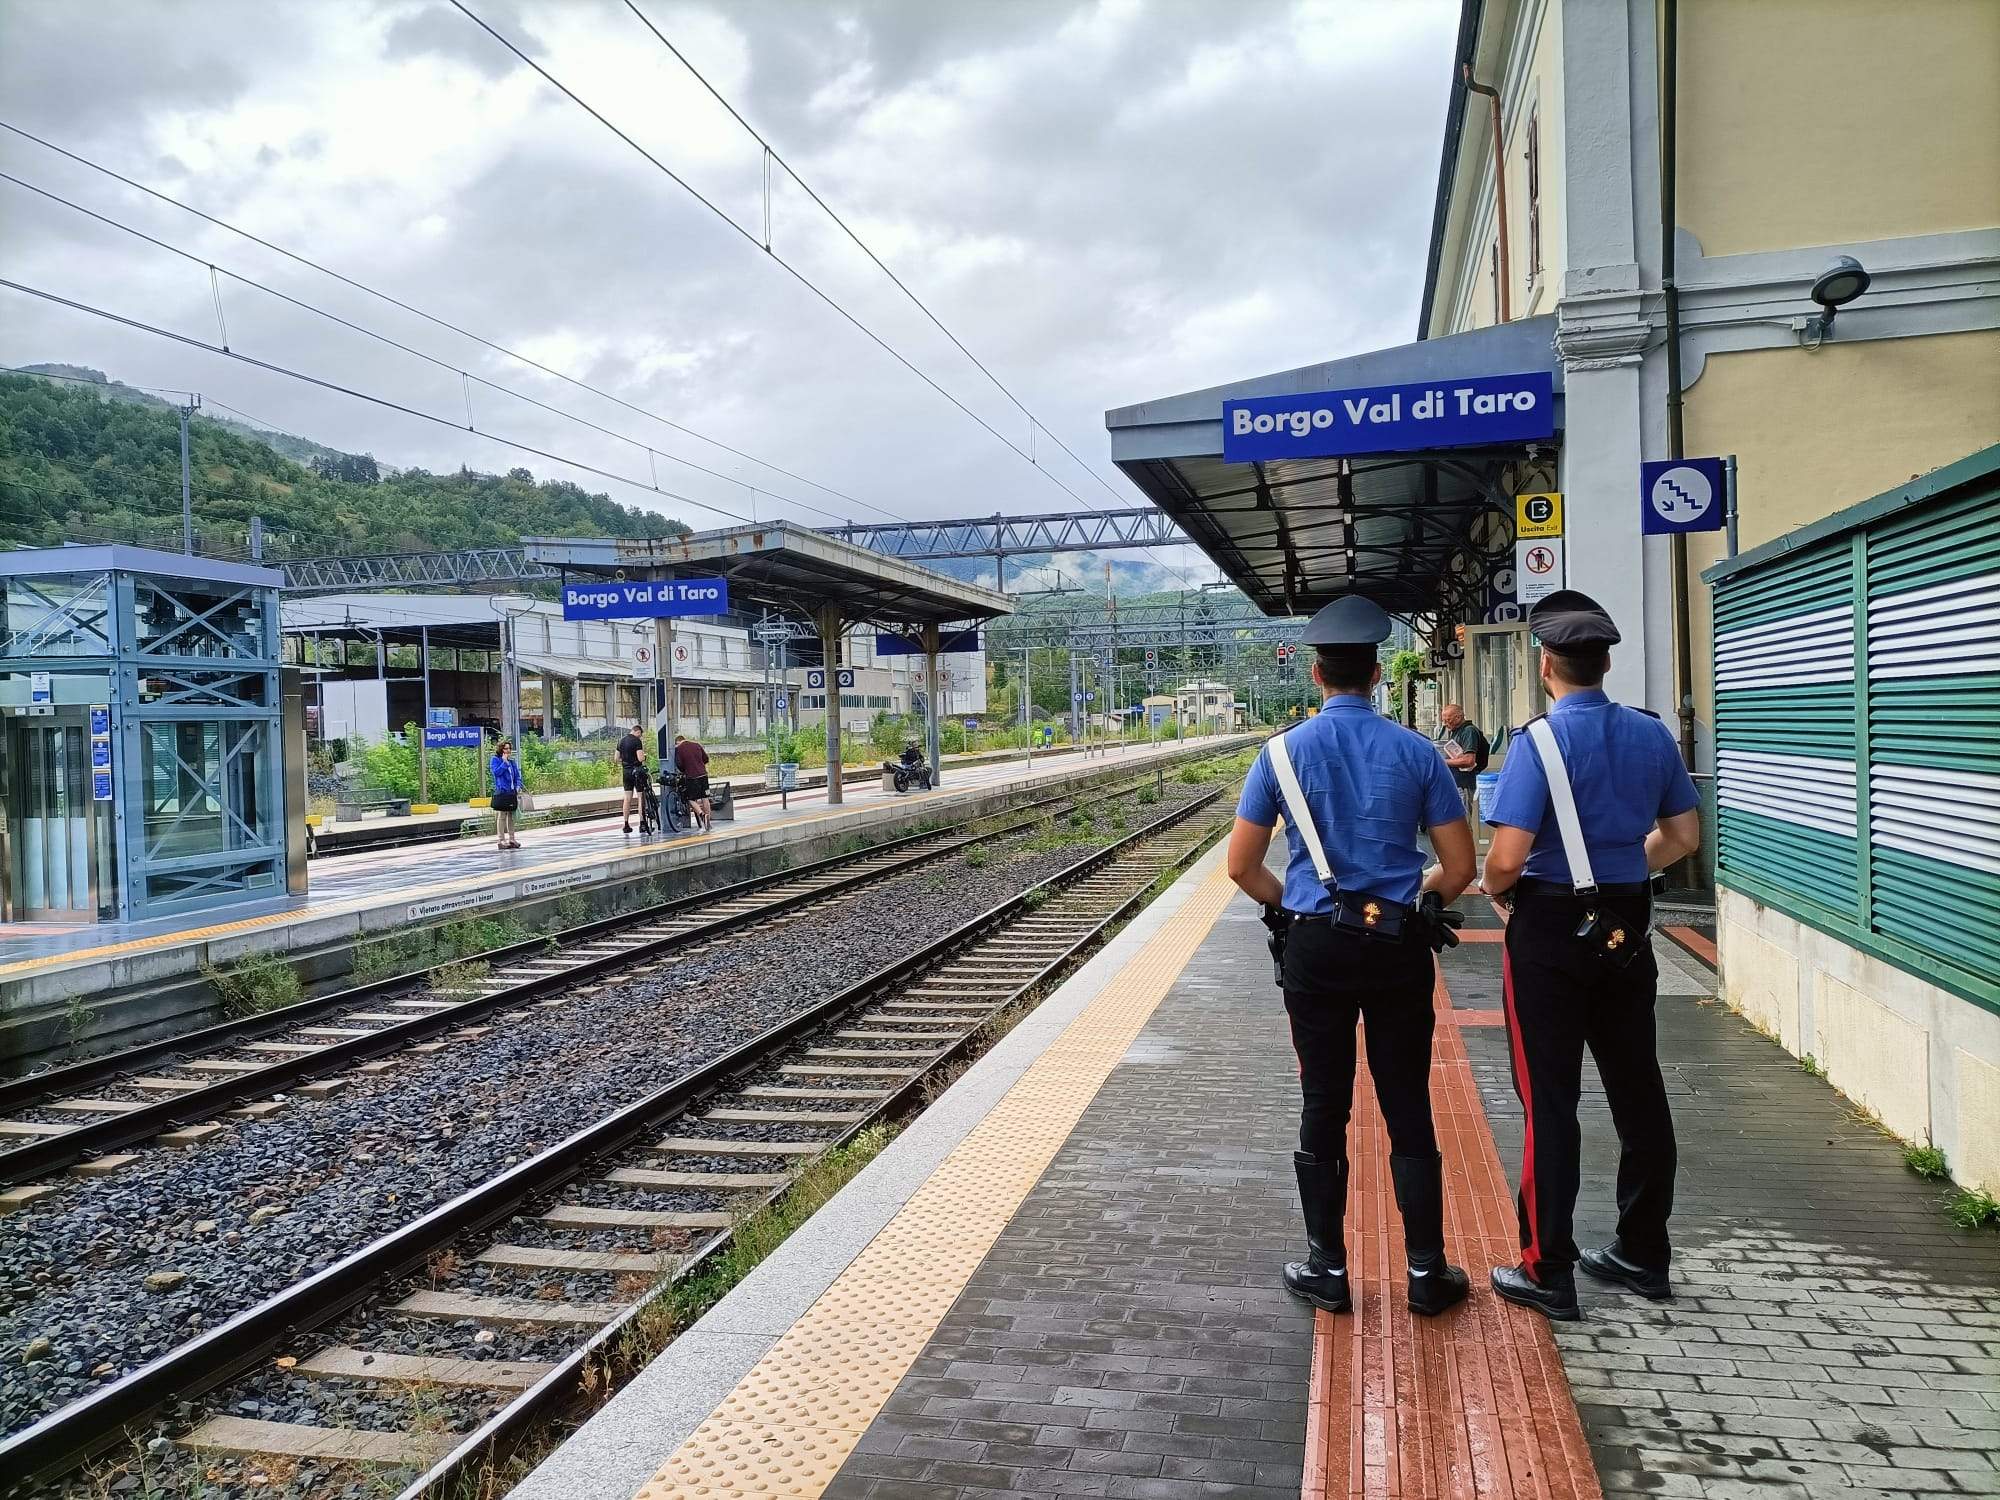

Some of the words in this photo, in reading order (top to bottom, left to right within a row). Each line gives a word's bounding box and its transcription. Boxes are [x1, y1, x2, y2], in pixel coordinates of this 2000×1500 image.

[1232, 408, 1334, 437] Borgo
[1343, 393, 1401, 425] Val
[1411, 390, 1445, 420] di
[1454, 388, 1536, 416] Taro
[1520, 525, 1545, 533] Uscita
[567, 590, 620, 608] Borgo
[623, 585, 653, 603] Val
[657, 584, 674, 601] di
[677, 584, 719, 601] Taro
[1451, 643, 1458, 654] 1
[842, 674, 849, 684] 2
[426, 731, 446, 742] Borgo
[447, 729, 458, 739] Val
[458, 729, 465, 739] di
[465, 730, 479, 738] Taro
